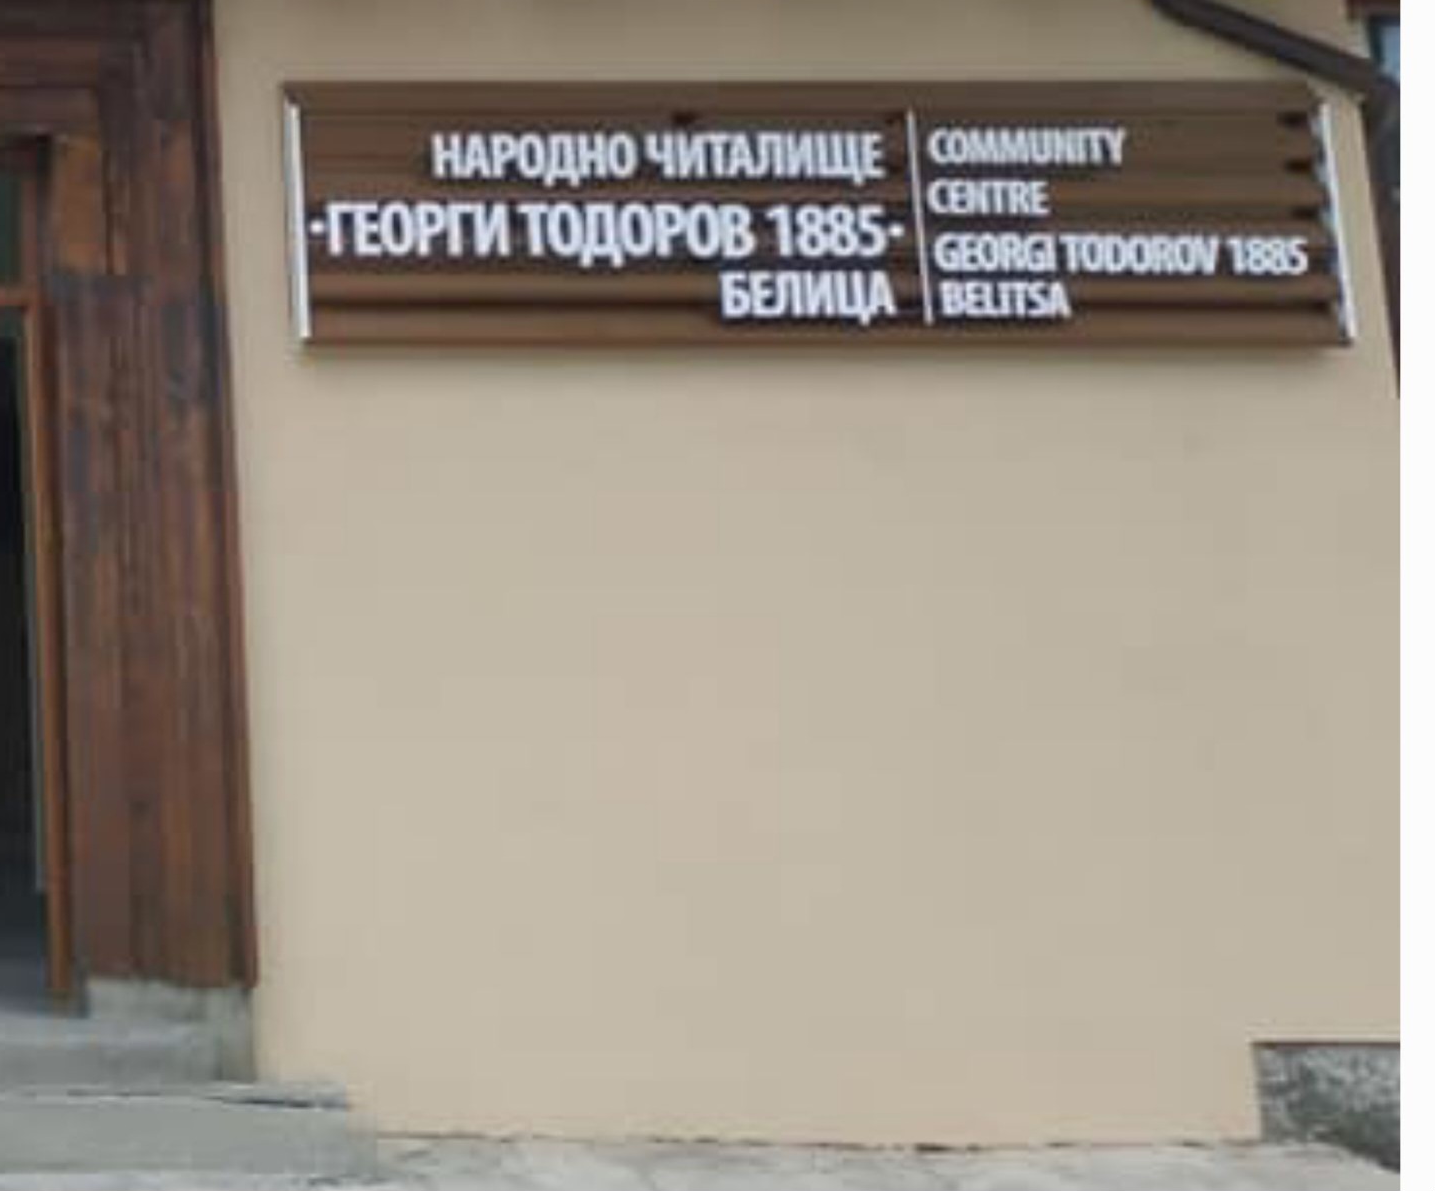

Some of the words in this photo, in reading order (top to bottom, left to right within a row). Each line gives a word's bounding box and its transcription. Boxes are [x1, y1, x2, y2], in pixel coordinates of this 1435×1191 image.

[431, 132, 638, 187] НАРОДНО
[644, 132, 884, 185] ЧИТАЛИЩЕ
[927, 127, 1126, 165] COMMUNITY
[927, 179, 1050, 216] CENTRE
[520, 204, 753, 268] ТОДОРОВ
[934, 232, 1057, 273] GEORGI
[1060, 235, 1219, 275] TODOROV
[1227, 237, 1308, 276] 1885
[720, 269, 896, 326] БЕЛИЦА
[940, 281, 1071, 319] BELITSA
